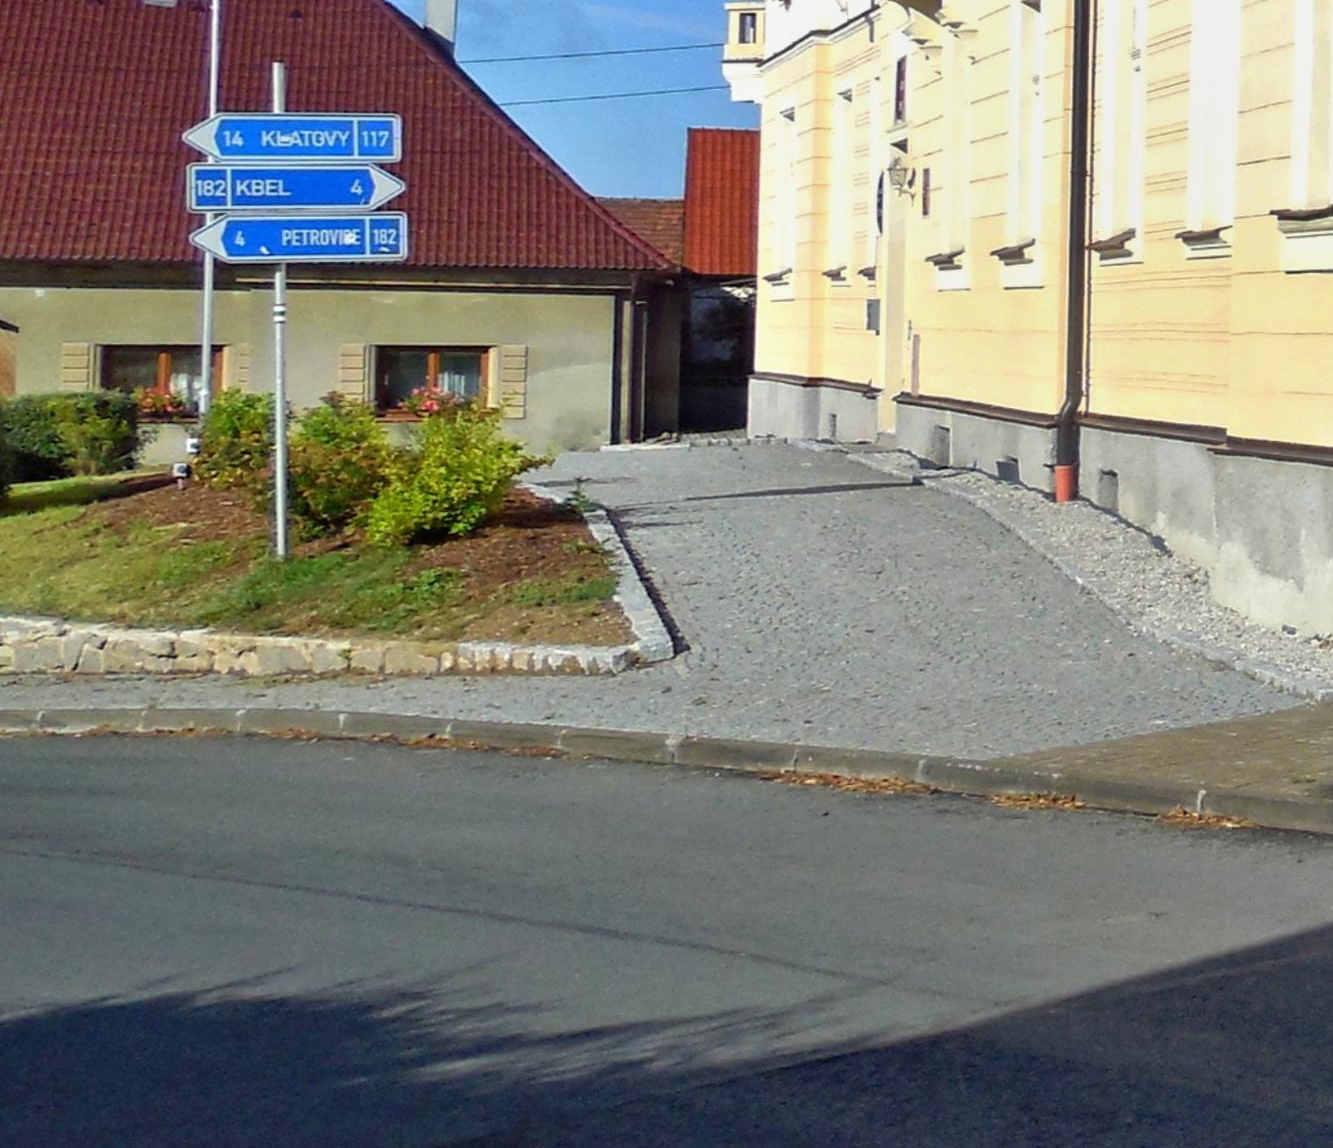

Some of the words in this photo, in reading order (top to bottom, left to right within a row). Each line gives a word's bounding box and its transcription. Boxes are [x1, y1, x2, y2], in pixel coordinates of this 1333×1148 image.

[223, 130, 245, 147] 14
[261, 130, 350, 147] KLATOVY
[362, 130, 390, 147] 117
[196, 179, 226, 197] 182
[235, 179, 292, 196] KBEL
[350, 179, 363, 195] 4
[235, 230, 246, 247] 4
[373, 228, 397, 245] 182
